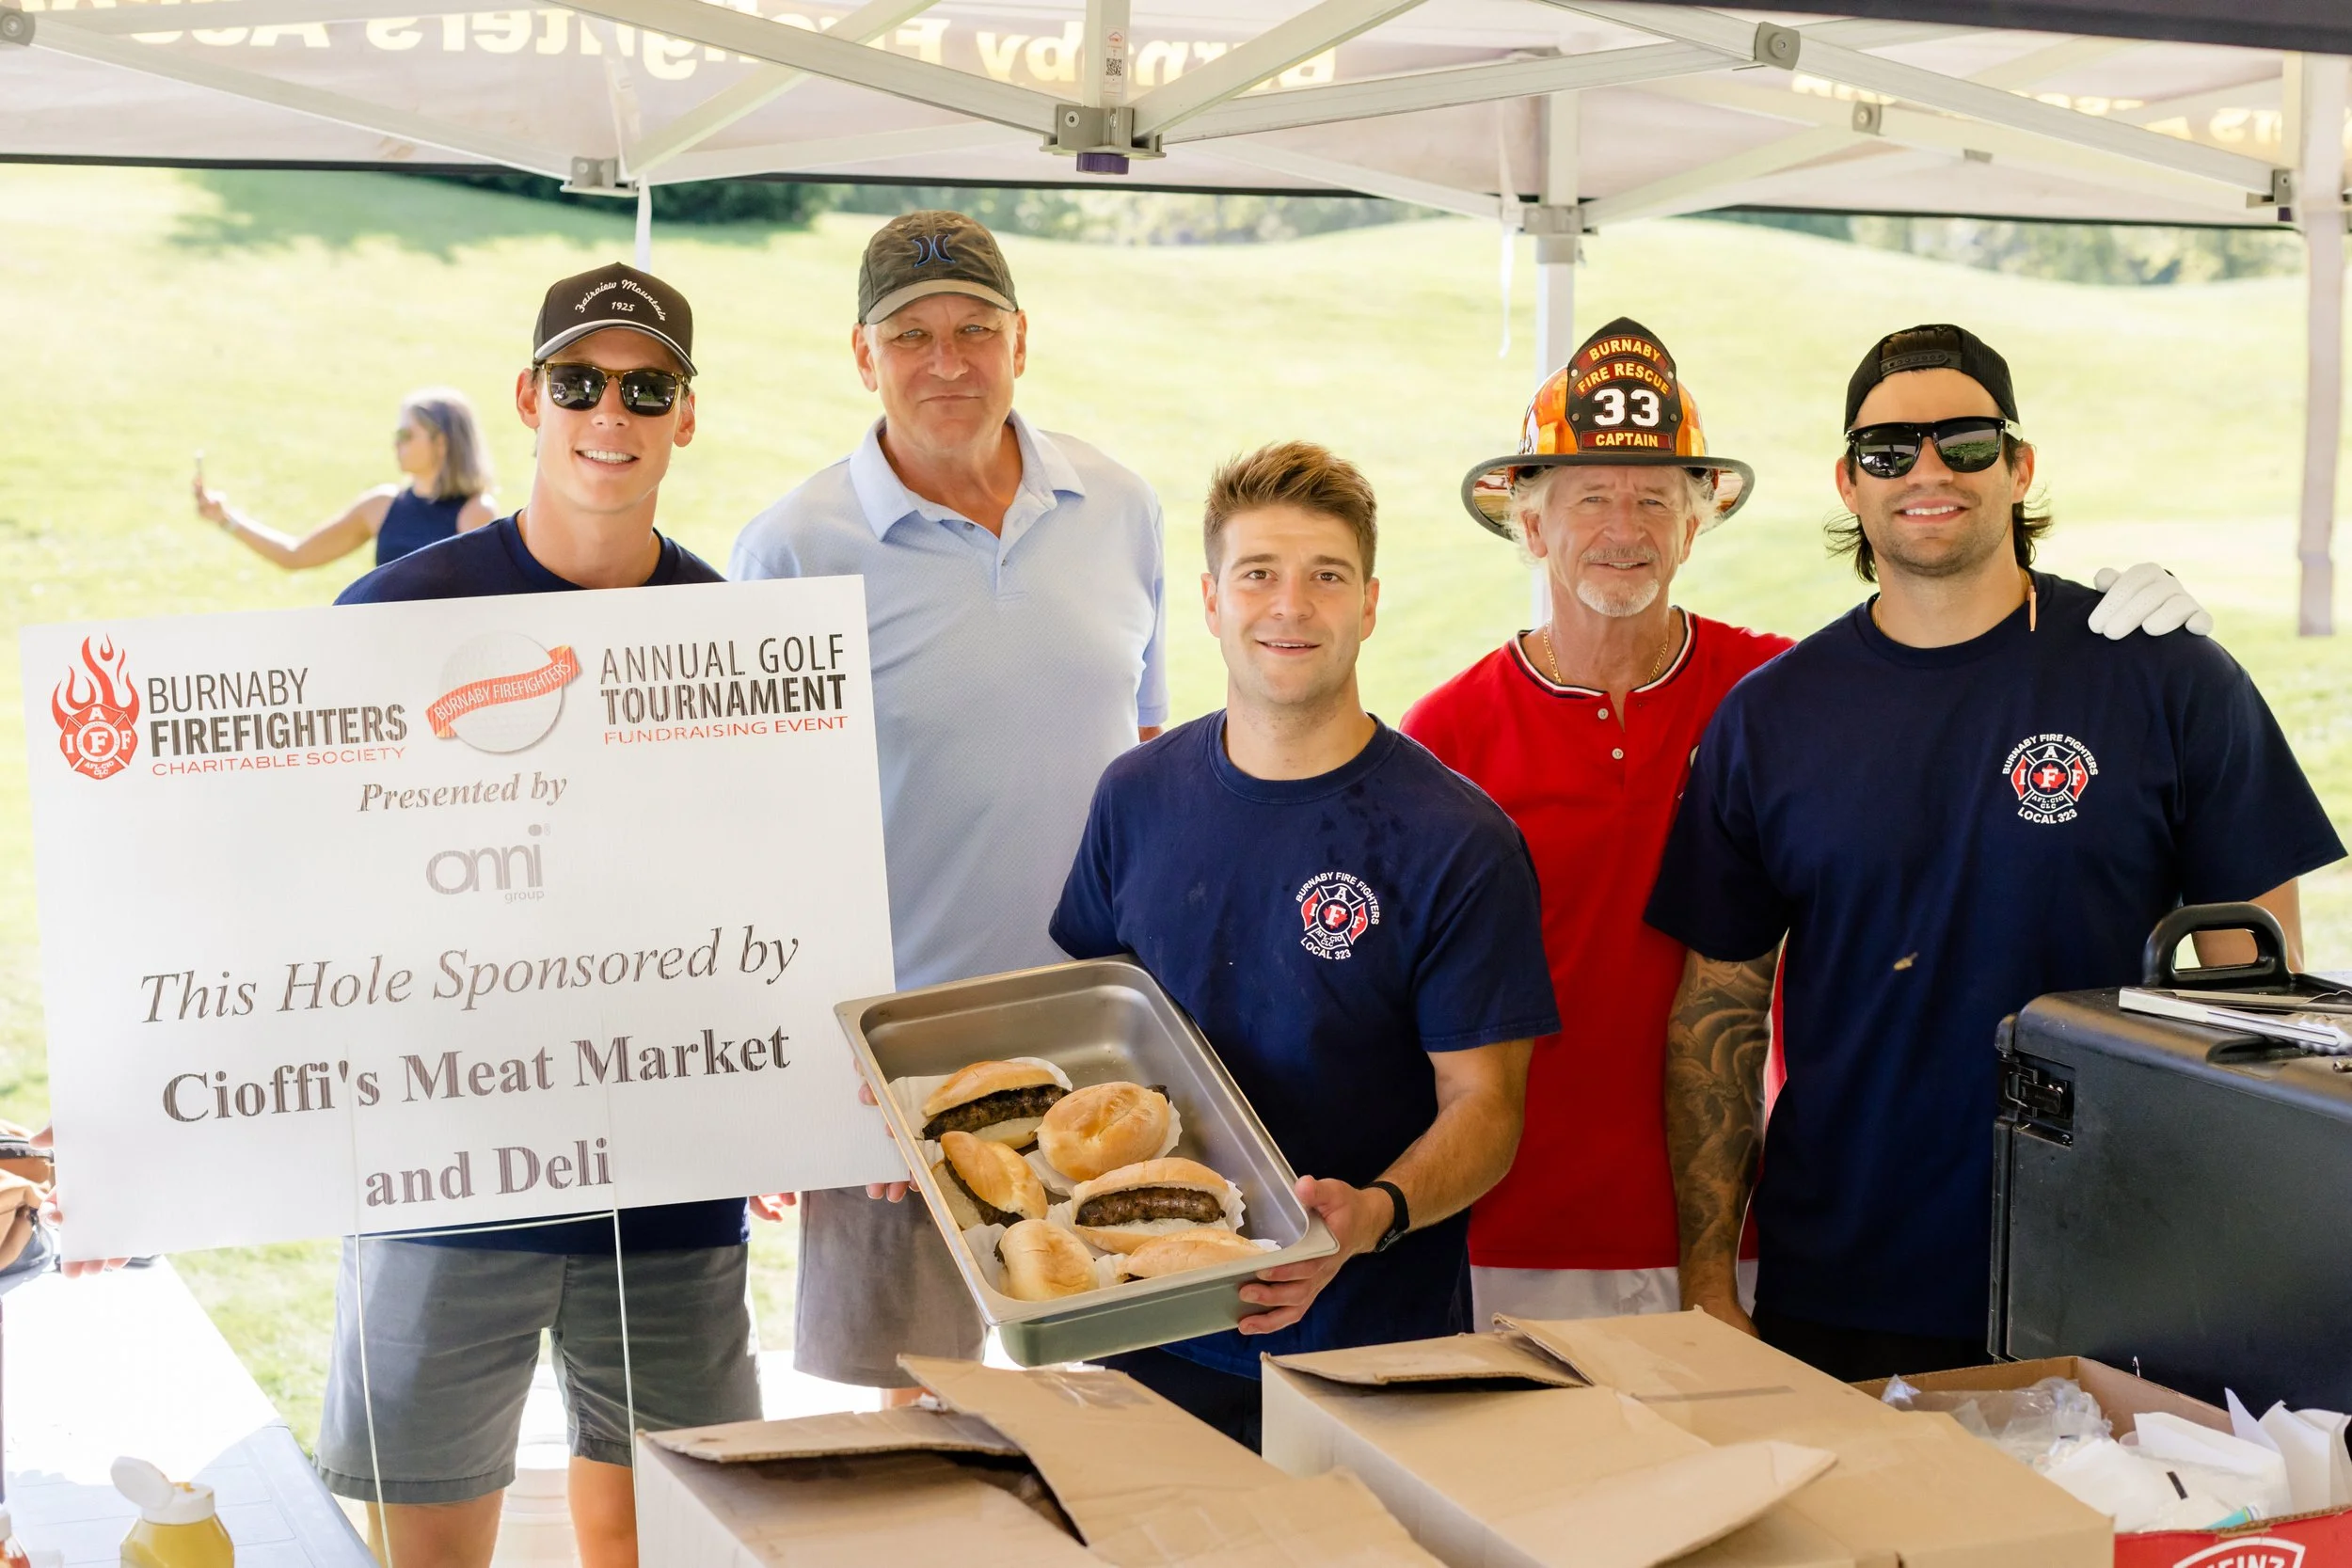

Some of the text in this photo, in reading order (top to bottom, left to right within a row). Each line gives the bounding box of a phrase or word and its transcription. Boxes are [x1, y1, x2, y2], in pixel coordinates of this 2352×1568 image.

[575, 279, 666, 321] Fairview Mountain
[612, 301, 635, 312] 1925
[1588, 339, 1661, 362] BURNABY
[1577, 363, 1669, 395] FIRE RESCUE
[1593, 388, 1661, 427] 33
[1595, 432, 1659, 448] CAPTAIN
[599, 633, 844, 685] ANNUAL GOLF
[147, 667, 309, 715] BURNABY
[433, 659, 571, 721] BURNABY FIREFIGHTERS
[599, 673, 847, 725] TOURNAMENT
[150, 704, 408, 758] FIREFIGHTERS
[603, 715, 849, 745] FUNDRAISING EVENT
[151, 747, 406, 777] CHARITABLE SOCIETY
[2001, 734, 2099, 776] BURNABY FIRE FIGHTERS
[357, 770, 567, 813] Presented by
[2017, 806, 2077, 824] LOCAL 323
[425, 823, 544, 895] onni
[504, 888, 545, 904] group
[1295, 871, 1380, 926] BURNABY FIRE FIGHTERS
[1300, 936, 1351, 960] LOCAL 323
[139, 924, 800, 1025] This Hole Sponsored by
[161, 1025, 791, 1124] Cioffi's Meat Market
[364, 1136, 613, 1208] and Deli
[2206, 1554, 2286, 1568] INZ
